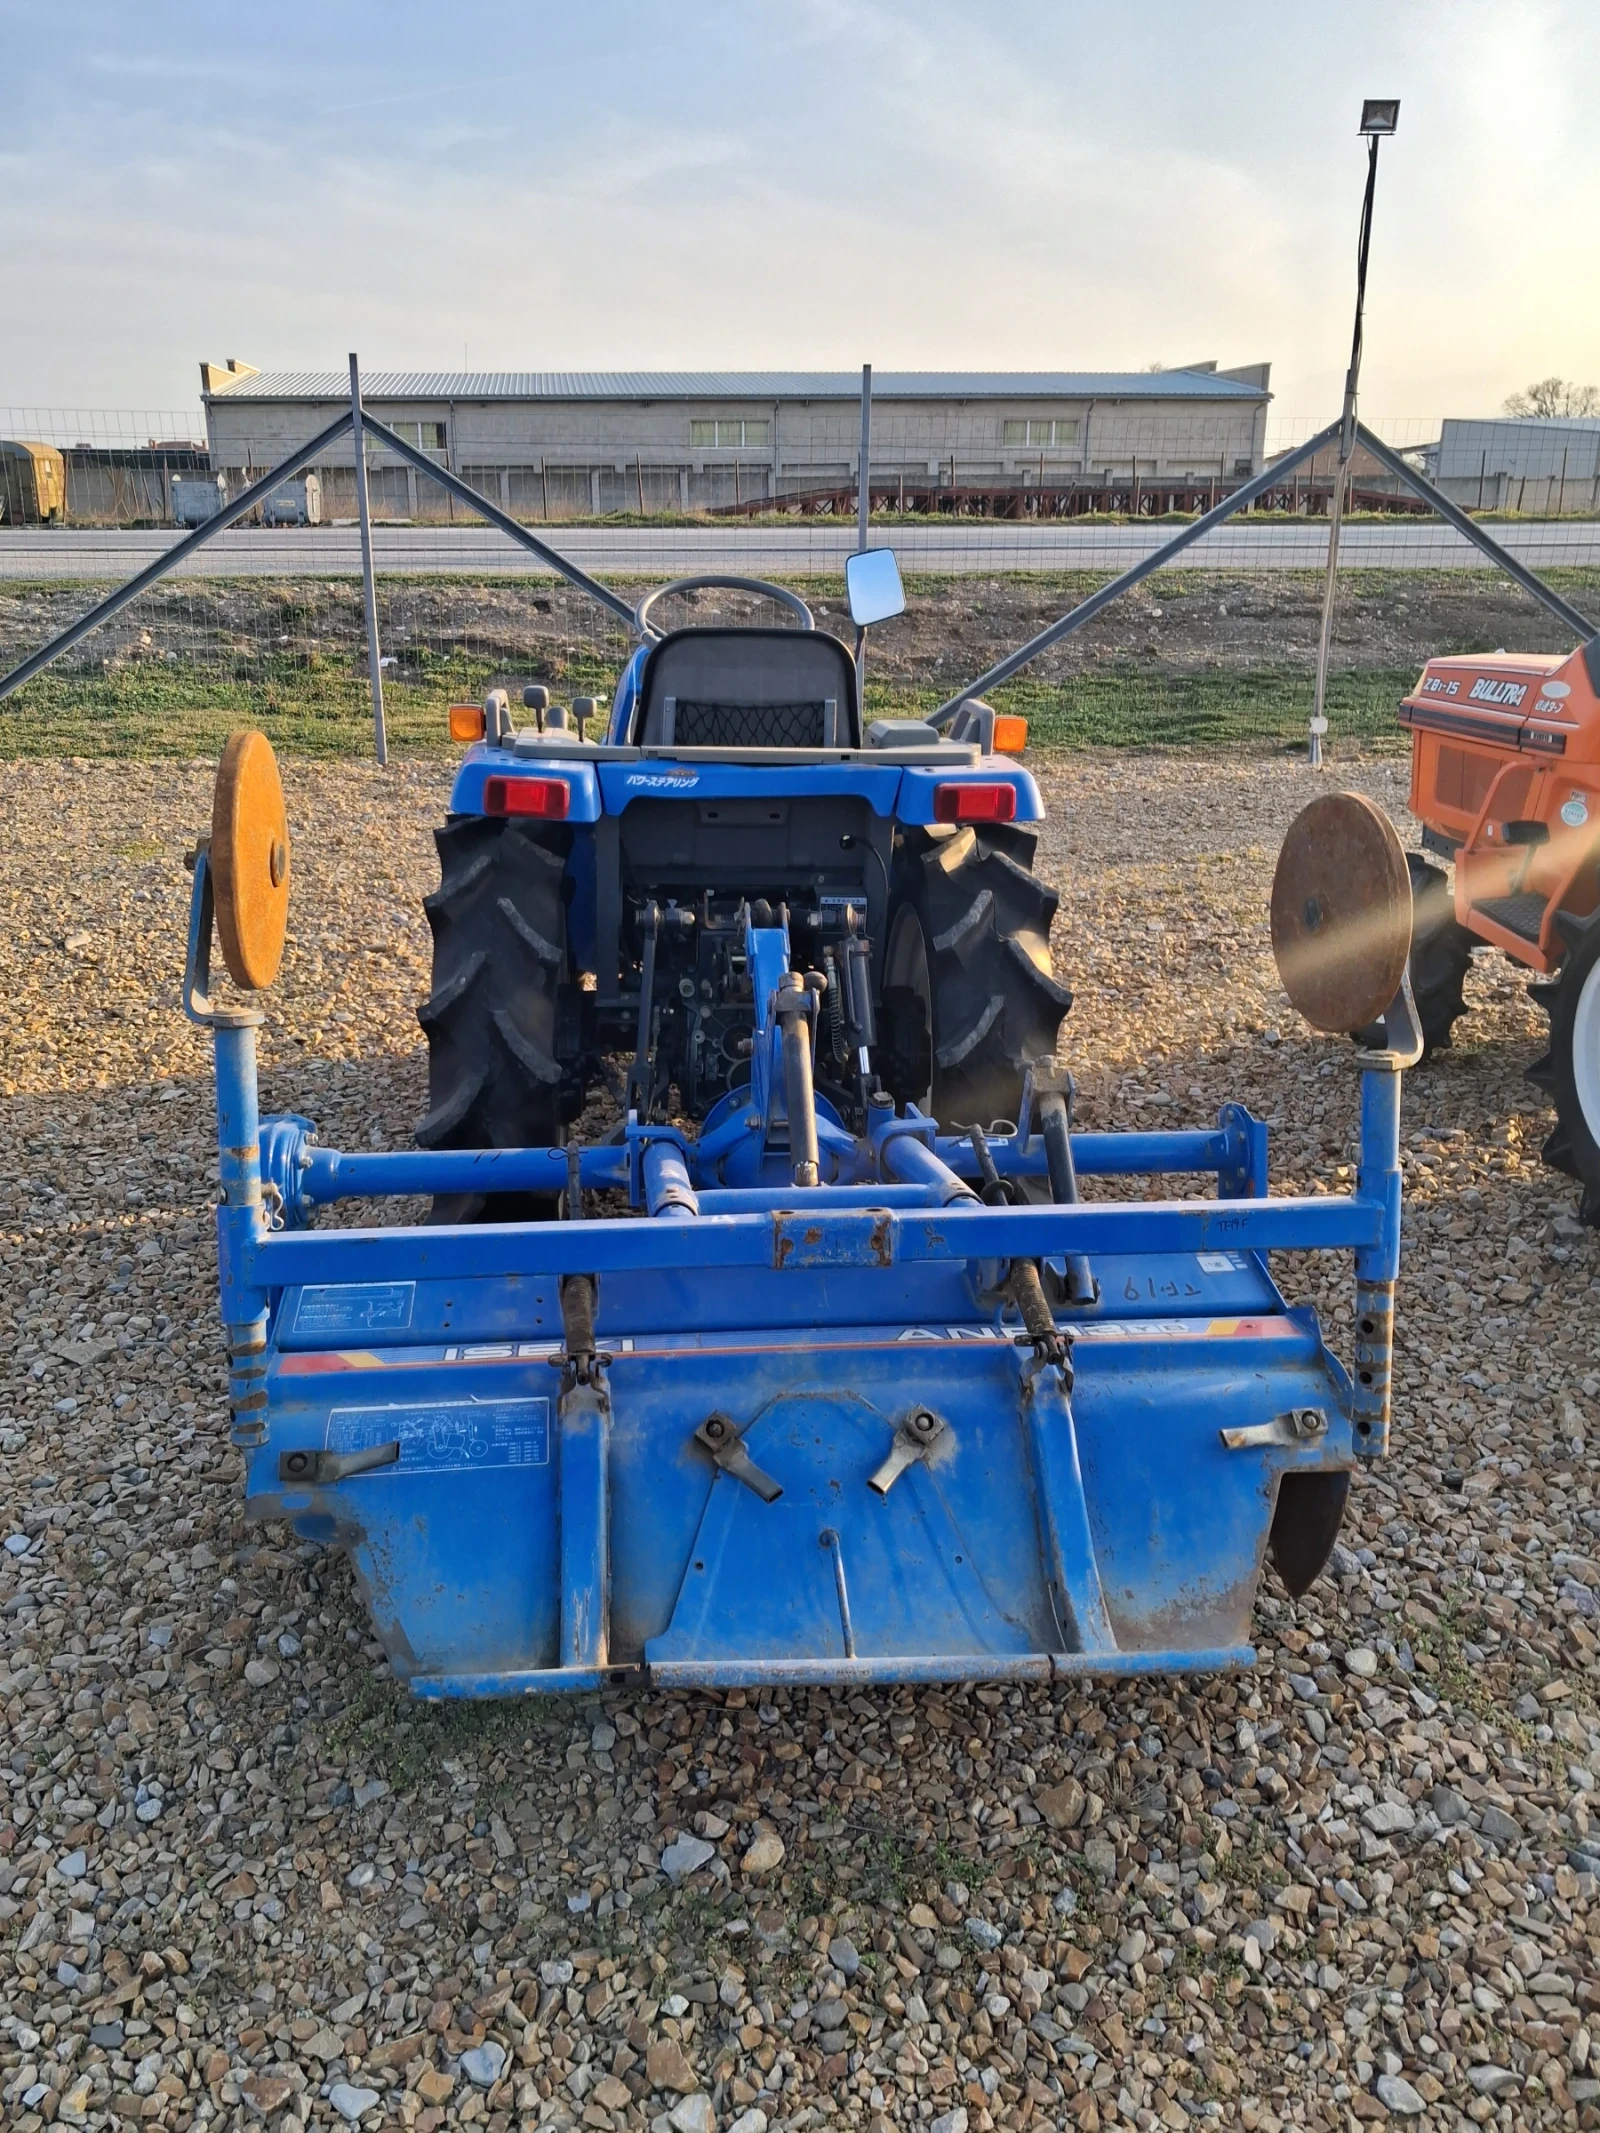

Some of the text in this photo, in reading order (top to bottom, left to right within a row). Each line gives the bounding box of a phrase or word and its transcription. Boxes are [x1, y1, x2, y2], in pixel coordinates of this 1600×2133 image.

[1468, 678, 1528, 706] BULLTRA
[626, 775, 700, 788] パワーステアリング
